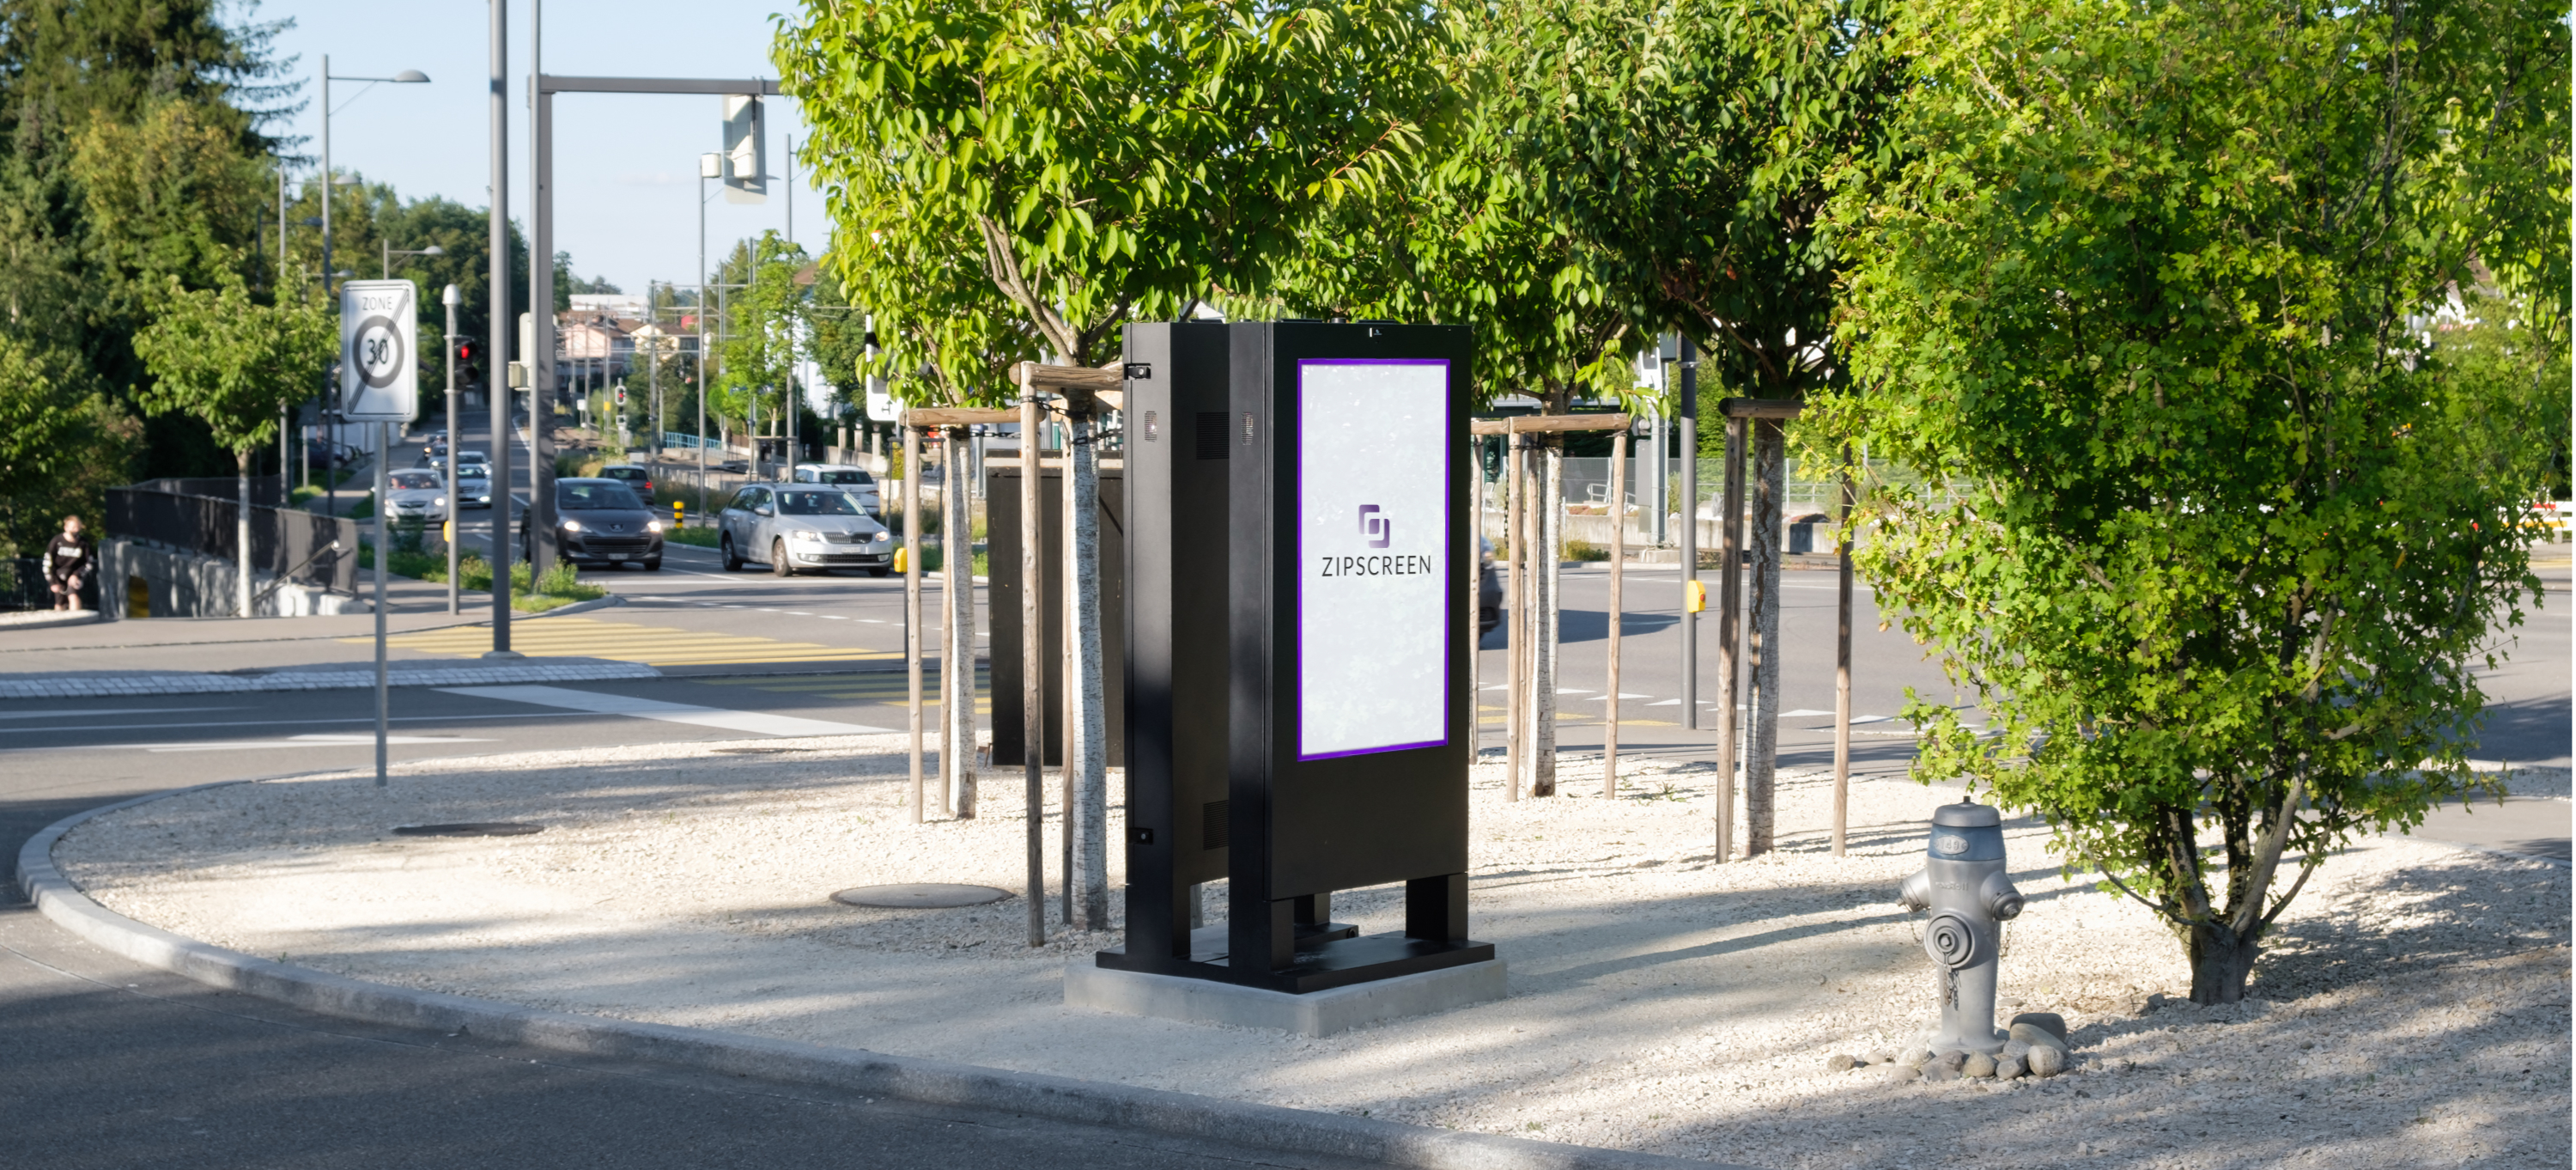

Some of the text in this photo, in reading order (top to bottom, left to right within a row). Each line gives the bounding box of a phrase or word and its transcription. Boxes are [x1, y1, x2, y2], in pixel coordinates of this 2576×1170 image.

[361, 296, 392, 311] ZONE
[367, 338, 389, 365] 30
[1321, 555, 1431, 577] ZIPSCREEN
[1941, 838, 1959, 851] 149
